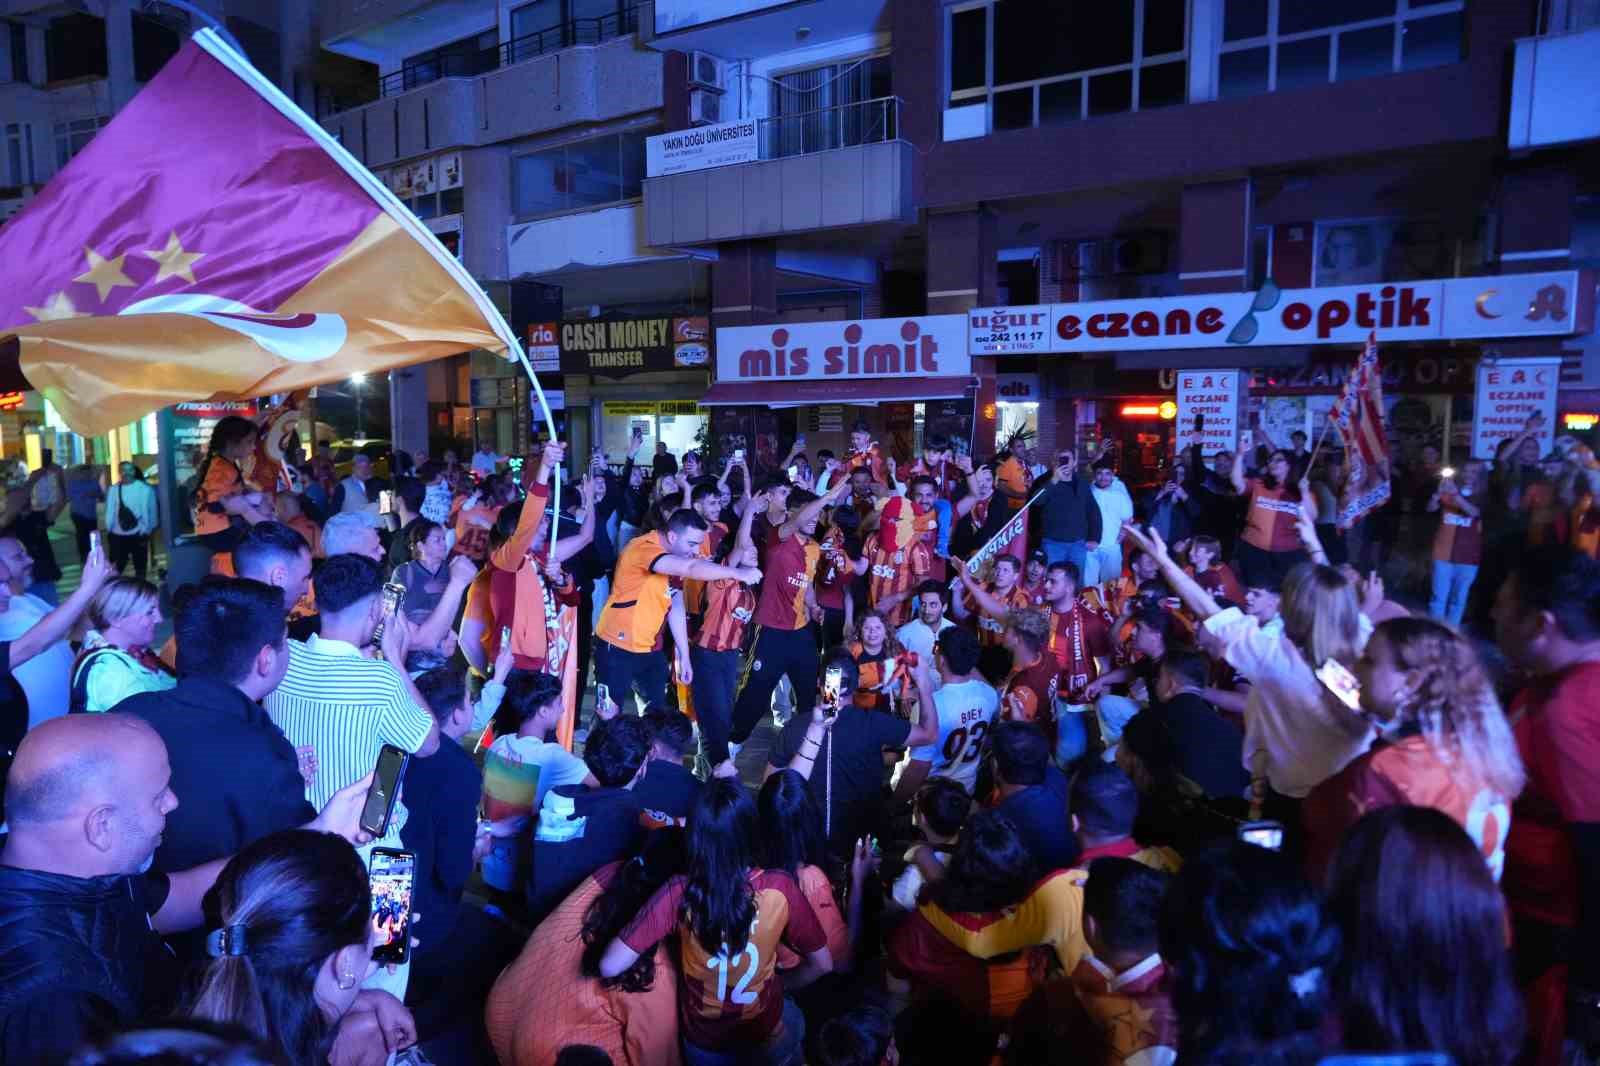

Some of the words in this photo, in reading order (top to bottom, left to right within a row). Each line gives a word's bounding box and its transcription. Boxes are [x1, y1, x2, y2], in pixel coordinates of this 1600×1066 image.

[663, 136, 683, 151] YAKIN
[684, 130, 705, 148] DOĞU
[706, 120, 755, 143] ÜNİVERSİTESİ
[971, 310, 1047, 333] uğur
[1057, 306, 1225, 341] eczane
[1281, 286, 1431, 338] optik
[531, 325, 554, 344] ria
[562, 322, 606, 351] CASH
[609, 319, 669, 349] MONEY
[990, 333, 1010, 342] 242
[1014, 333, 1026, 341] 11
[1030, 331, 1043, 340] 17
[588, 350, 644, 368] TRANSFER
[739, 328, 809, 377] mis
[823, 319, 938, 375] simit
[1185, 394, 1230, 404] ECZANE
[1488, 391, 1546, 401] ECZANE
[1180, 417, 1232, 426] PHMACY
[463, 527, 488, 552] 45
[942, 720, 989, 768] 93
[706, 942, 759, 1004] 12
